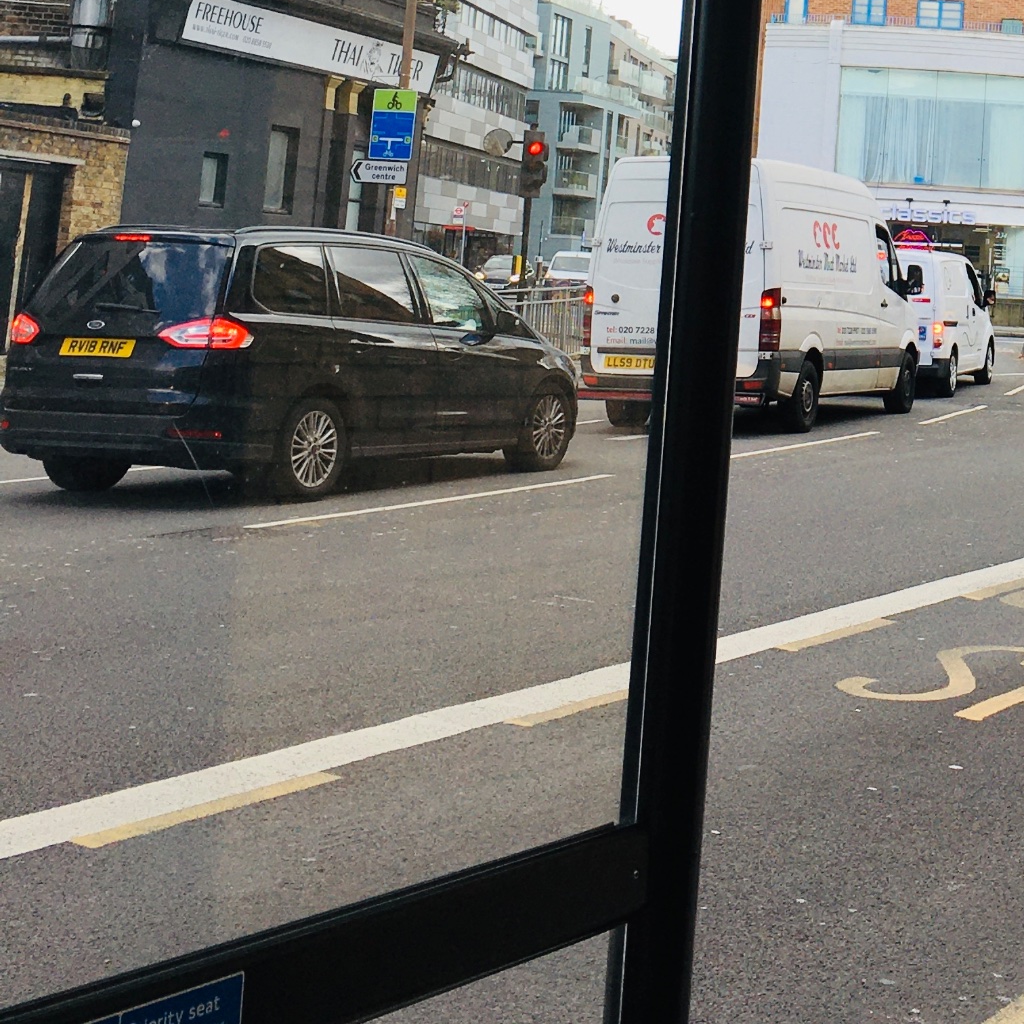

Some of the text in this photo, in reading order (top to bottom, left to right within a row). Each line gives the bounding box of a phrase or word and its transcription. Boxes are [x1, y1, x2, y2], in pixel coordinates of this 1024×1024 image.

[194, 1, 265, 35] FREEHOUSE
[331, 38, 364, 68] THAI
[364, 163, 405, 173] Greenwich
[371, 172, 396, 181] centre
[882, 203, 976, 225] classics
[606, 237, 662, 255] Westminster
[606, 326, 655, 335] tel: 020 7228
[68, 340, 127, 354] RV18 RNF
[606, 336, 628, 345] Email:
[606, 357, 633, 368] LL59
[188, 995, 221, 1021] seat
